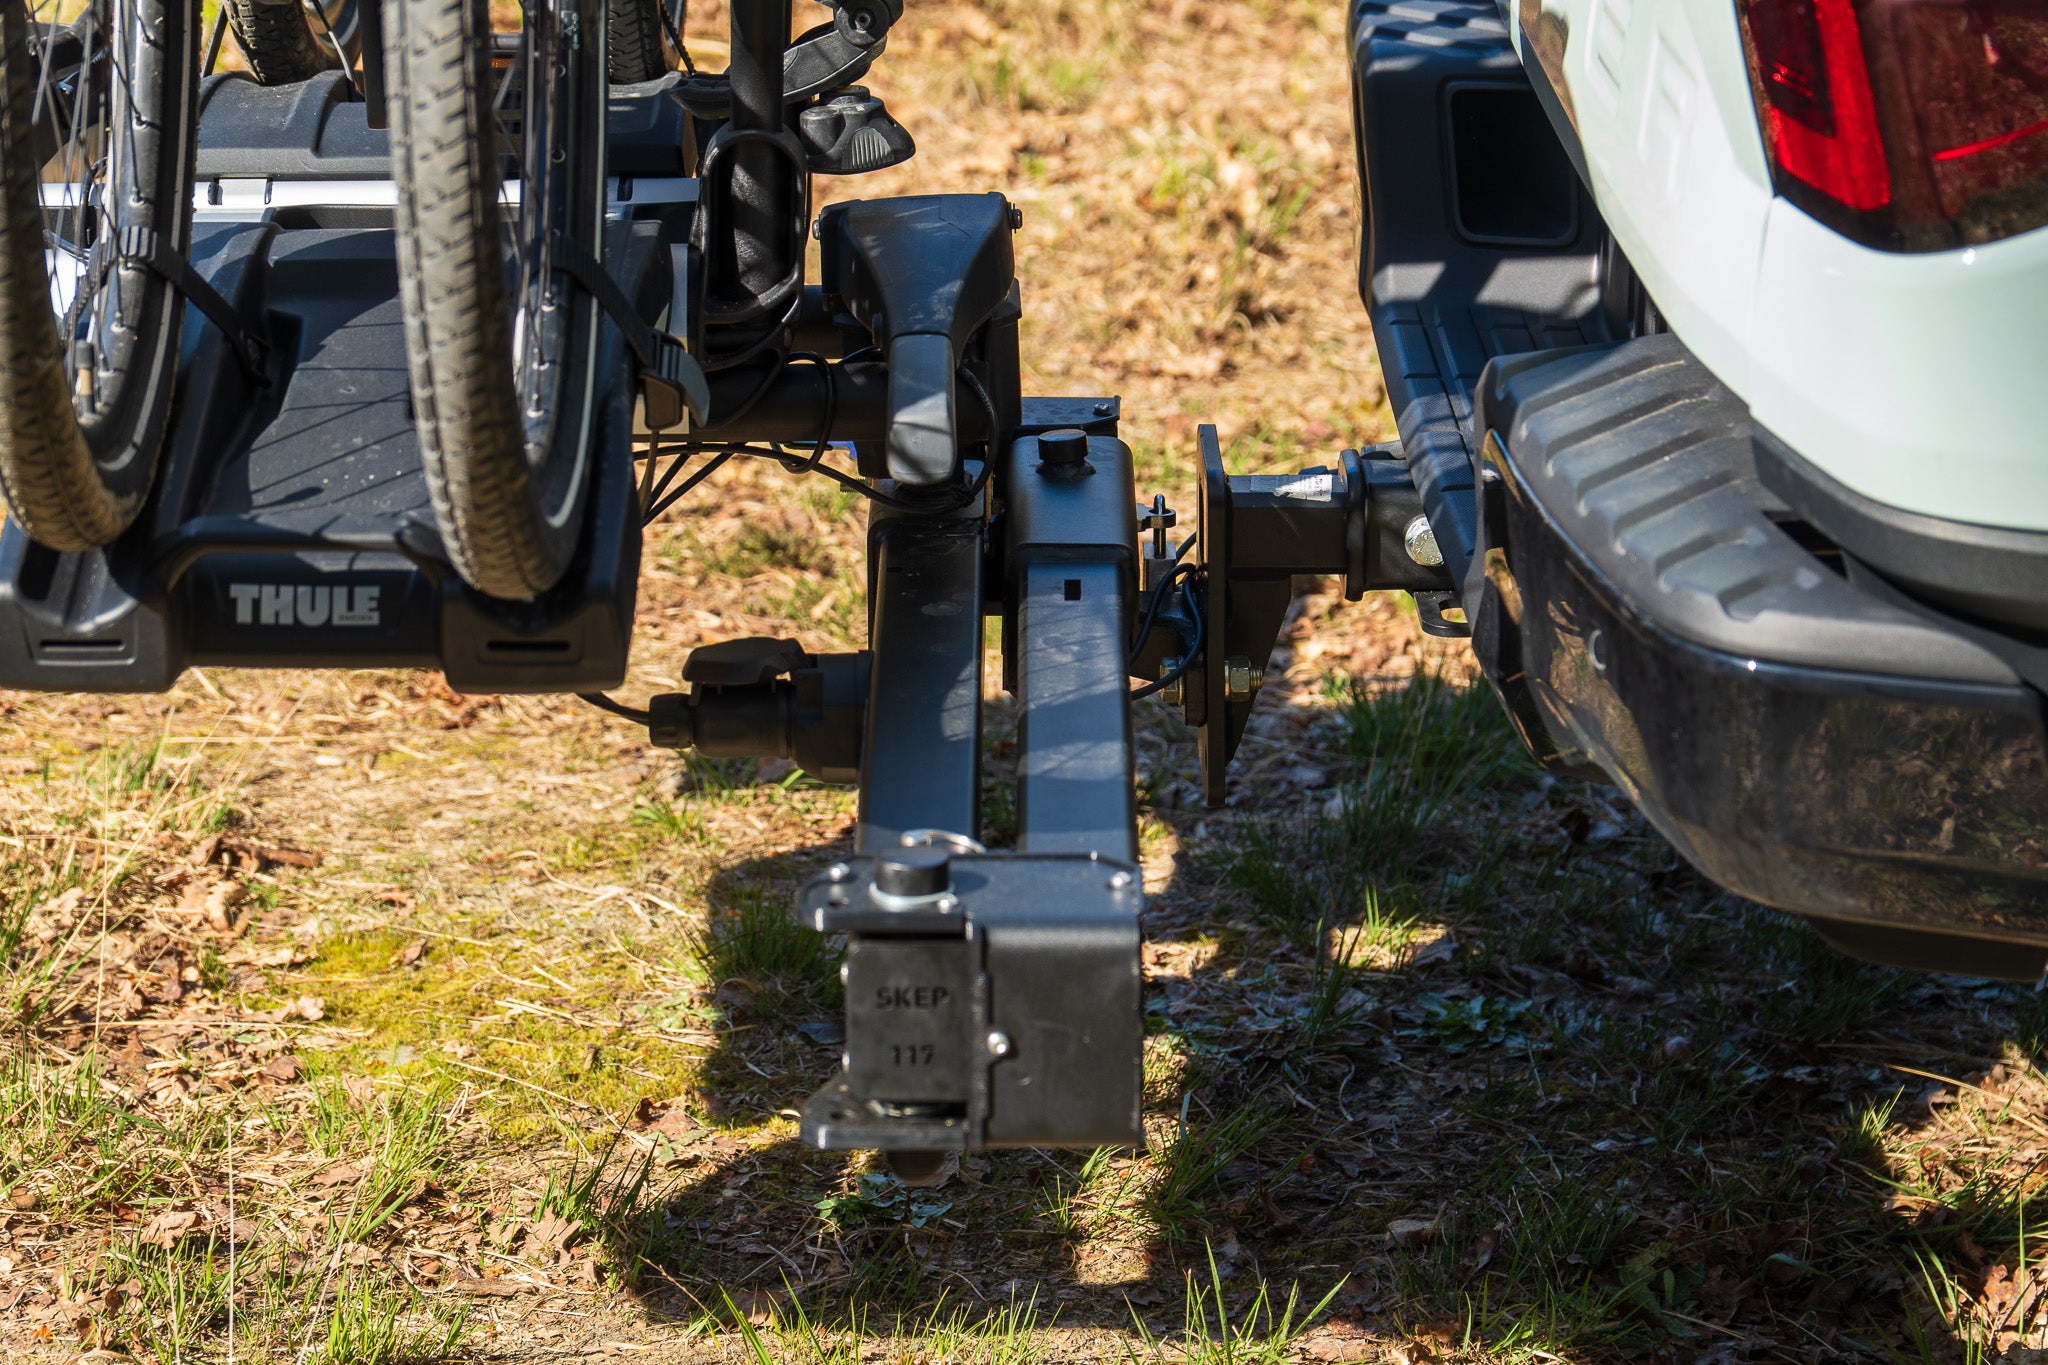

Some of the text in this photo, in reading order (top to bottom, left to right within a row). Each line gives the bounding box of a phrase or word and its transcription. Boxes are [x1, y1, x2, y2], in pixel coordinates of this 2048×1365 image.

[229, 583, 381, 627] THULE
[876, 986, 949, 1008] SKEP
[889, 1040, 936, 1065] 117
